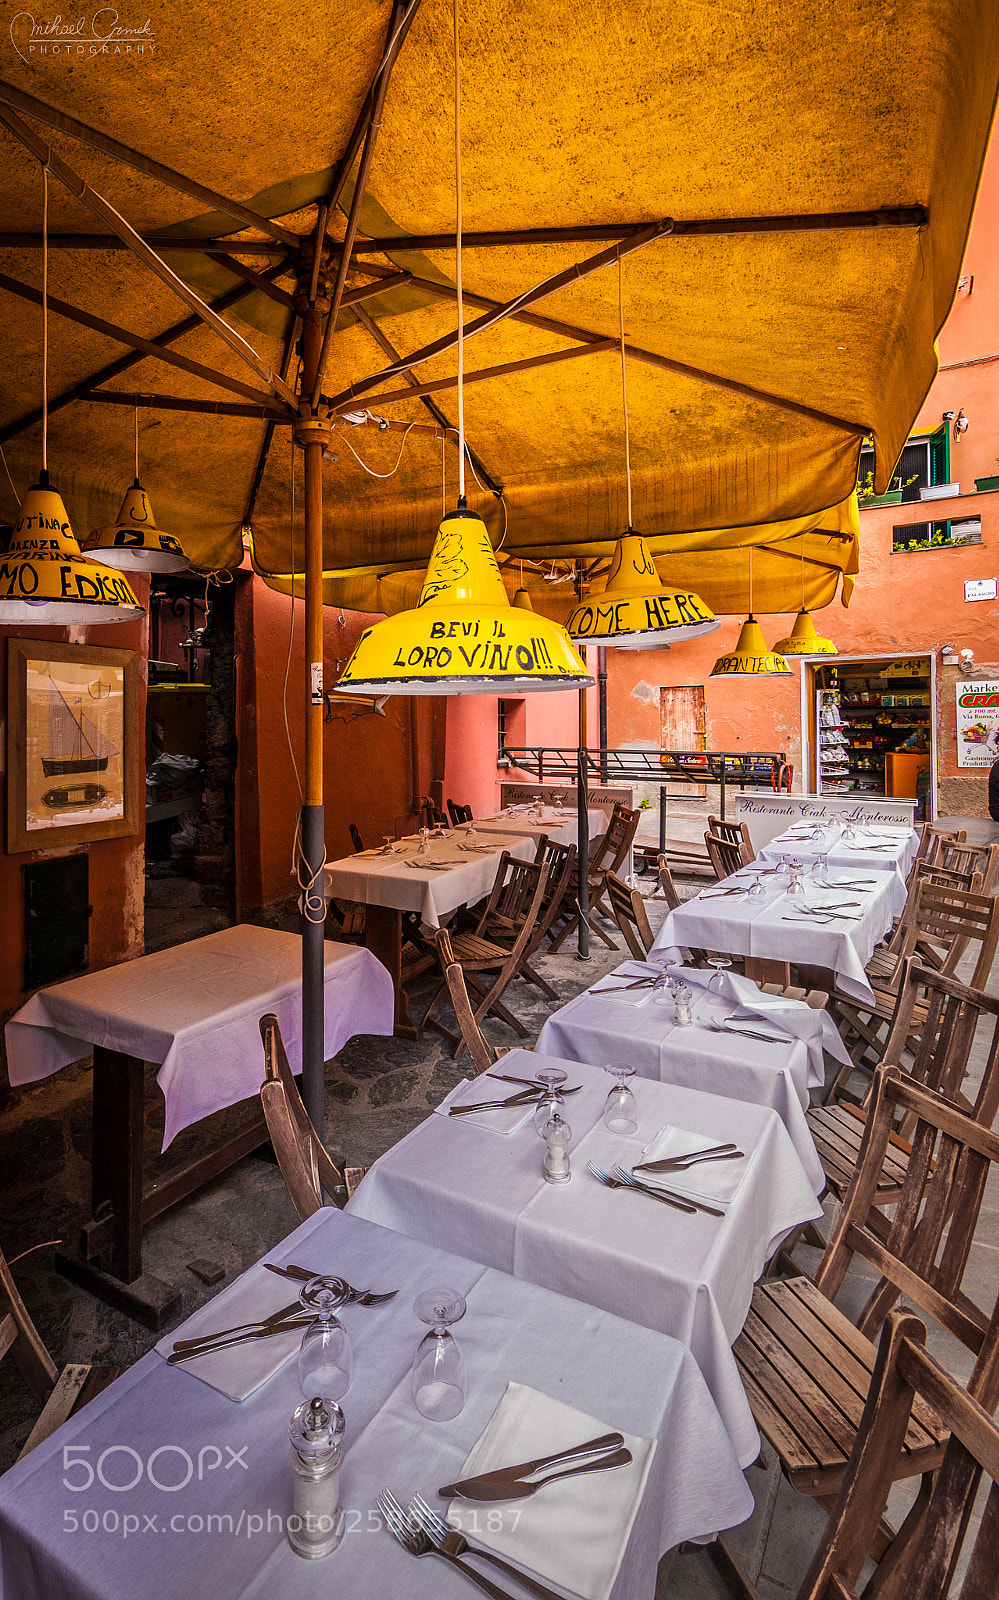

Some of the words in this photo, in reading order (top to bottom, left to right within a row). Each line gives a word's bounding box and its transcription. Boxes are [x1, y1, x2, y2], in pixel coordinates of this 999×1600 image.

[645, 594, 709, 629] HERE
[393, 644, 452, 668] LORO
[963, 683, 999, 693] Marke
[739, 798, 795, 816] Ristorante
[799, 801, 828, 818] Ciak
[840, 805, 909, 824] Monterosso
